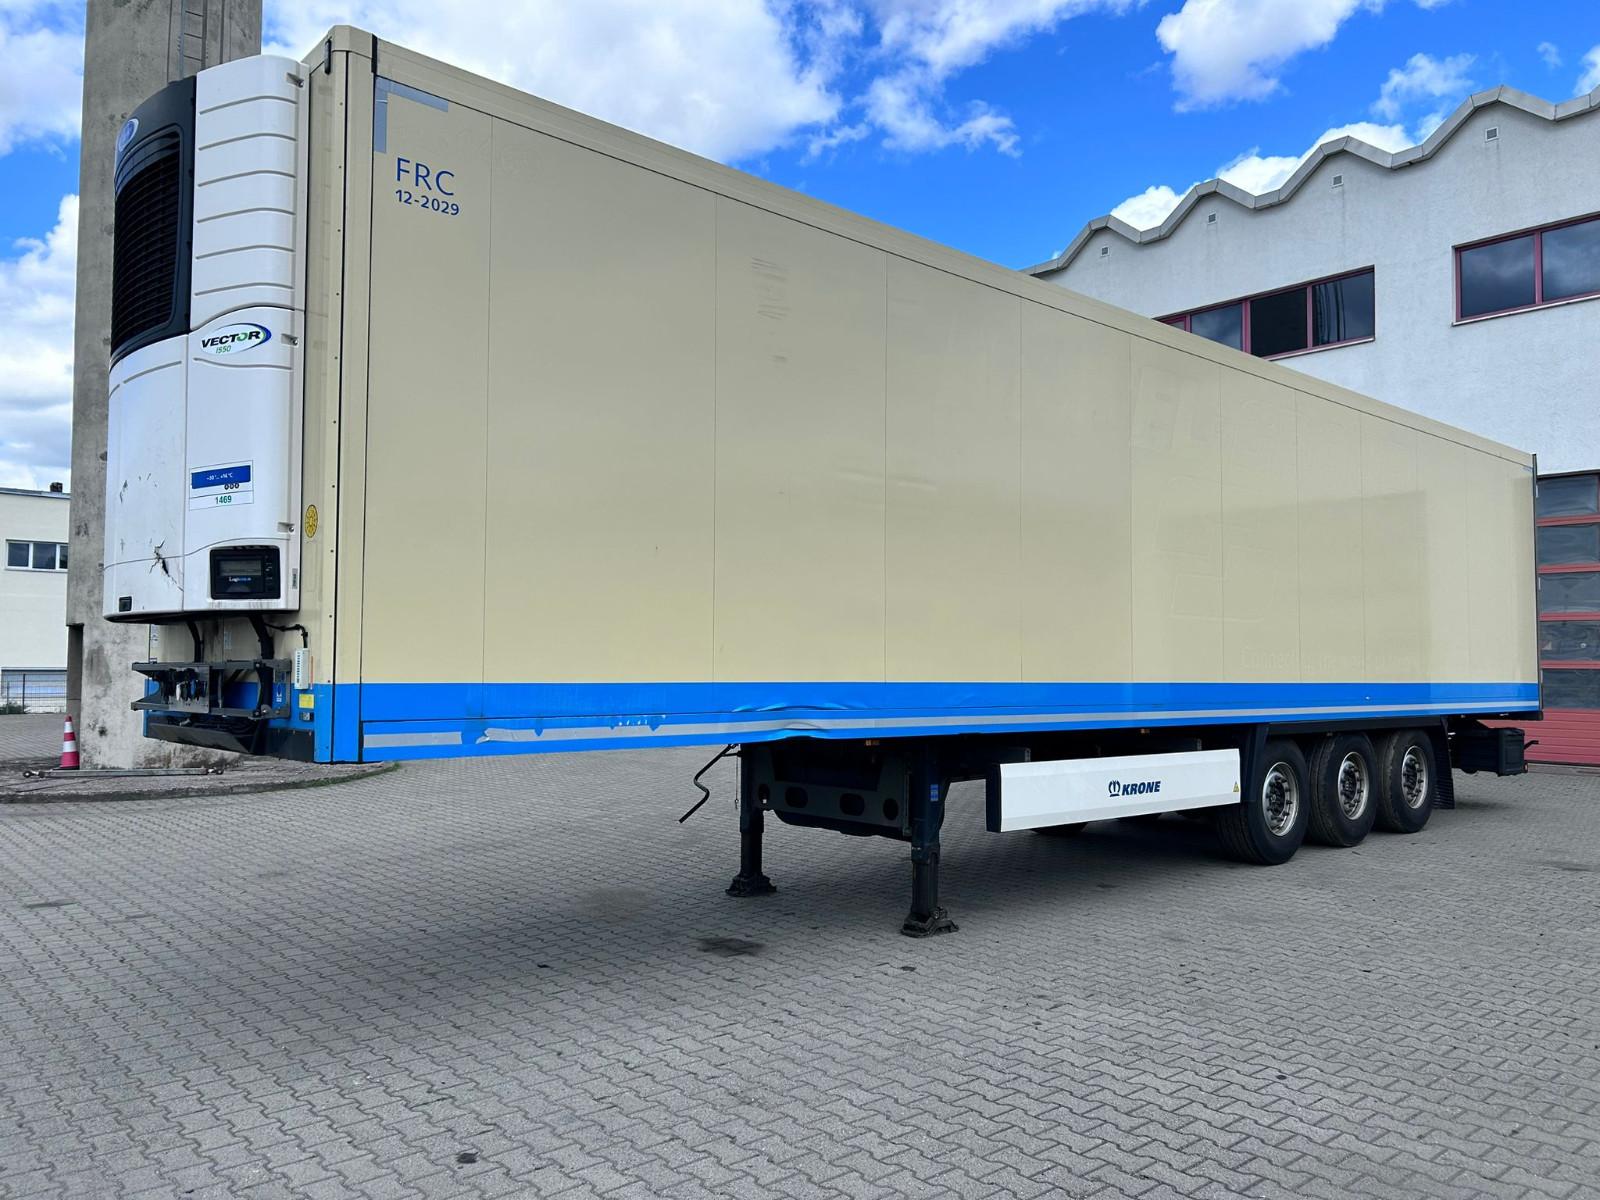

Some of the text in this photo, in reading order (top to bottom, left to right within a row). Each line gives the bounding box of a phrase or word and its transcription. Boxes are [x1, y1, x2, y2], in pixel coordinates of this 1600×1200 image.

[396, 156, 456, 196] FRC
[395, 189, 460, 216] 12-2029
[201, 330, 261, 348] VECTOR
[215, 495, 232, 504] 1469
[1121, 780, 1162, 796] KRONE
